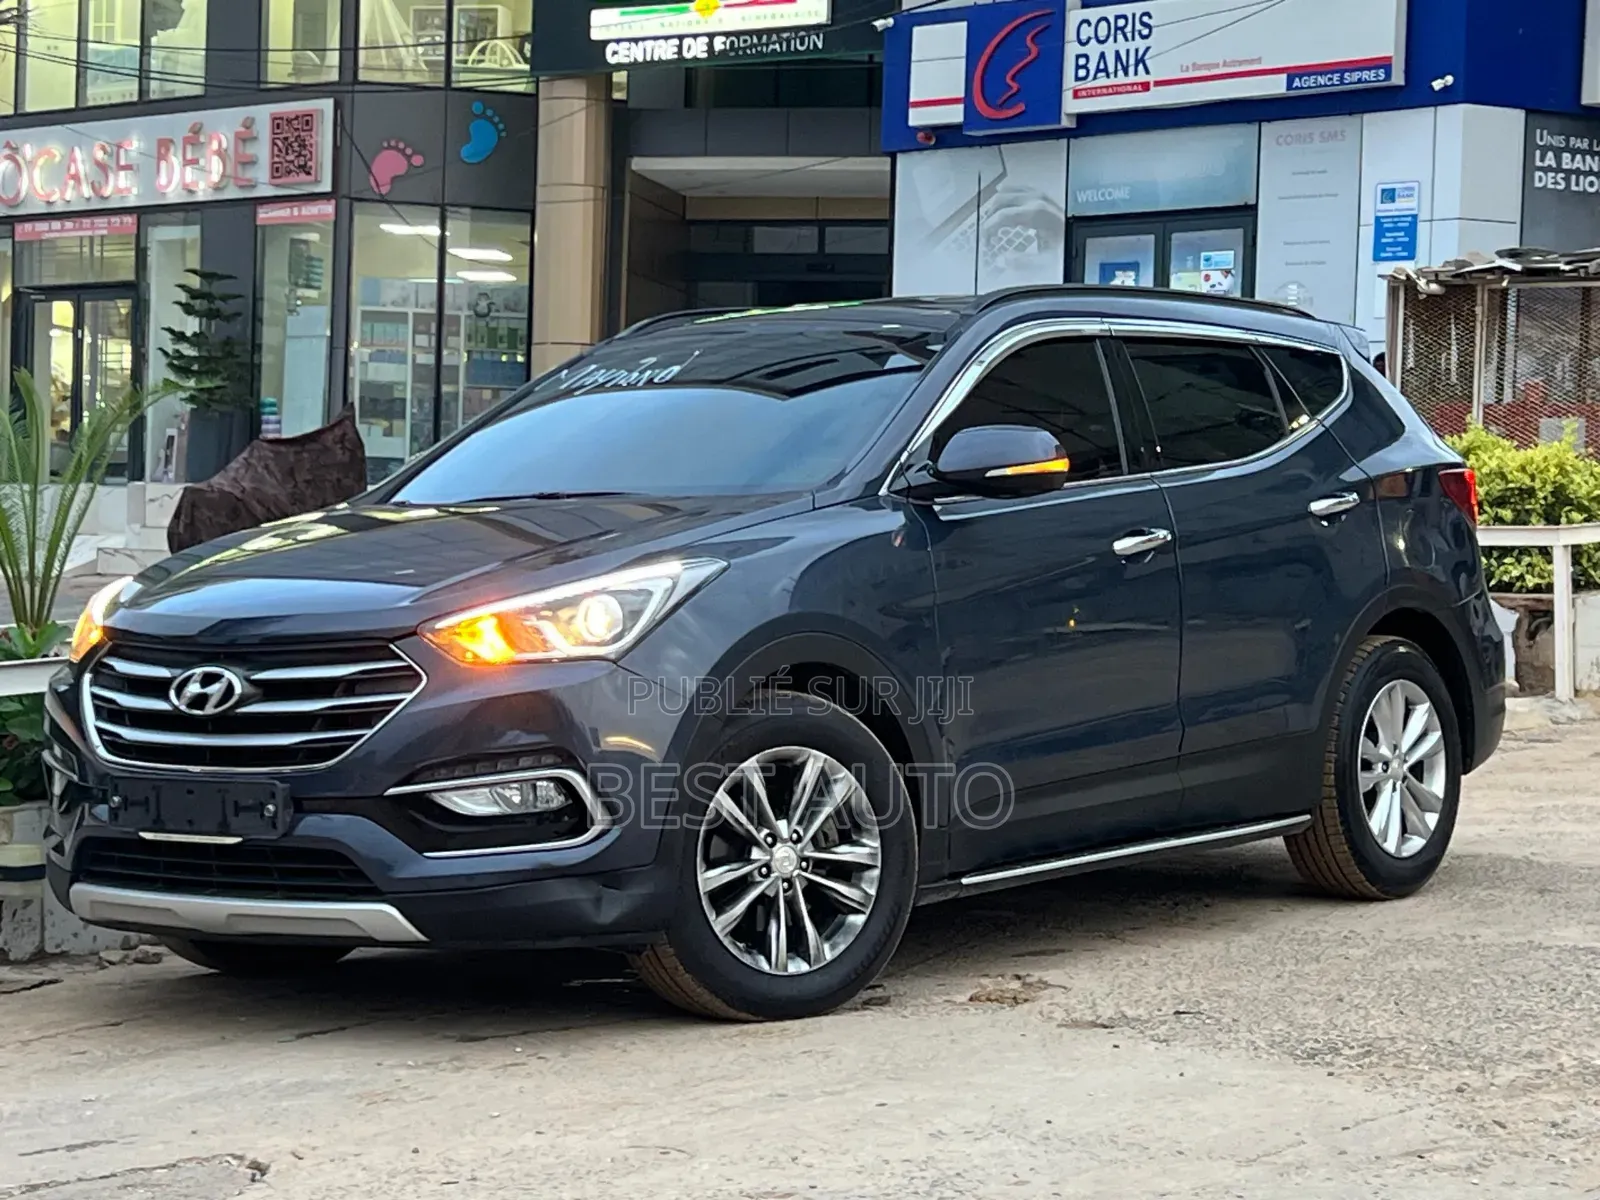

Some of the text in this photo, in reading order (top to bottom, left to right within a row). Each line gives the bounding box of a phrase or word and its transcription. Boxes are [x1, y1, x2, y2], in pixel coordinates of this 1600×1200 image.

[1076, 11, 1153, 47] CORIS
[604, 31, 824, 64] CENTRE DE FORMATION
[1074, 46, 1152, 82] BANK
[1292, 68, 1386, 89] AGENCE SIPRES
[1077, 83, 1144, 97] INTERNATIONAL
[1275, 129, 1347, 147] CORIS SMS
[1569, 136, 1590, 150] PAR
[1592, 138, 1600, 151] L
[156, 116, 259, 194] BÉBÉ
[1535, 149, 1557, 168] LA
[1534, 170, 1600, 193] DES LIO
[1076, 186, 1131, 203] WELCOME
